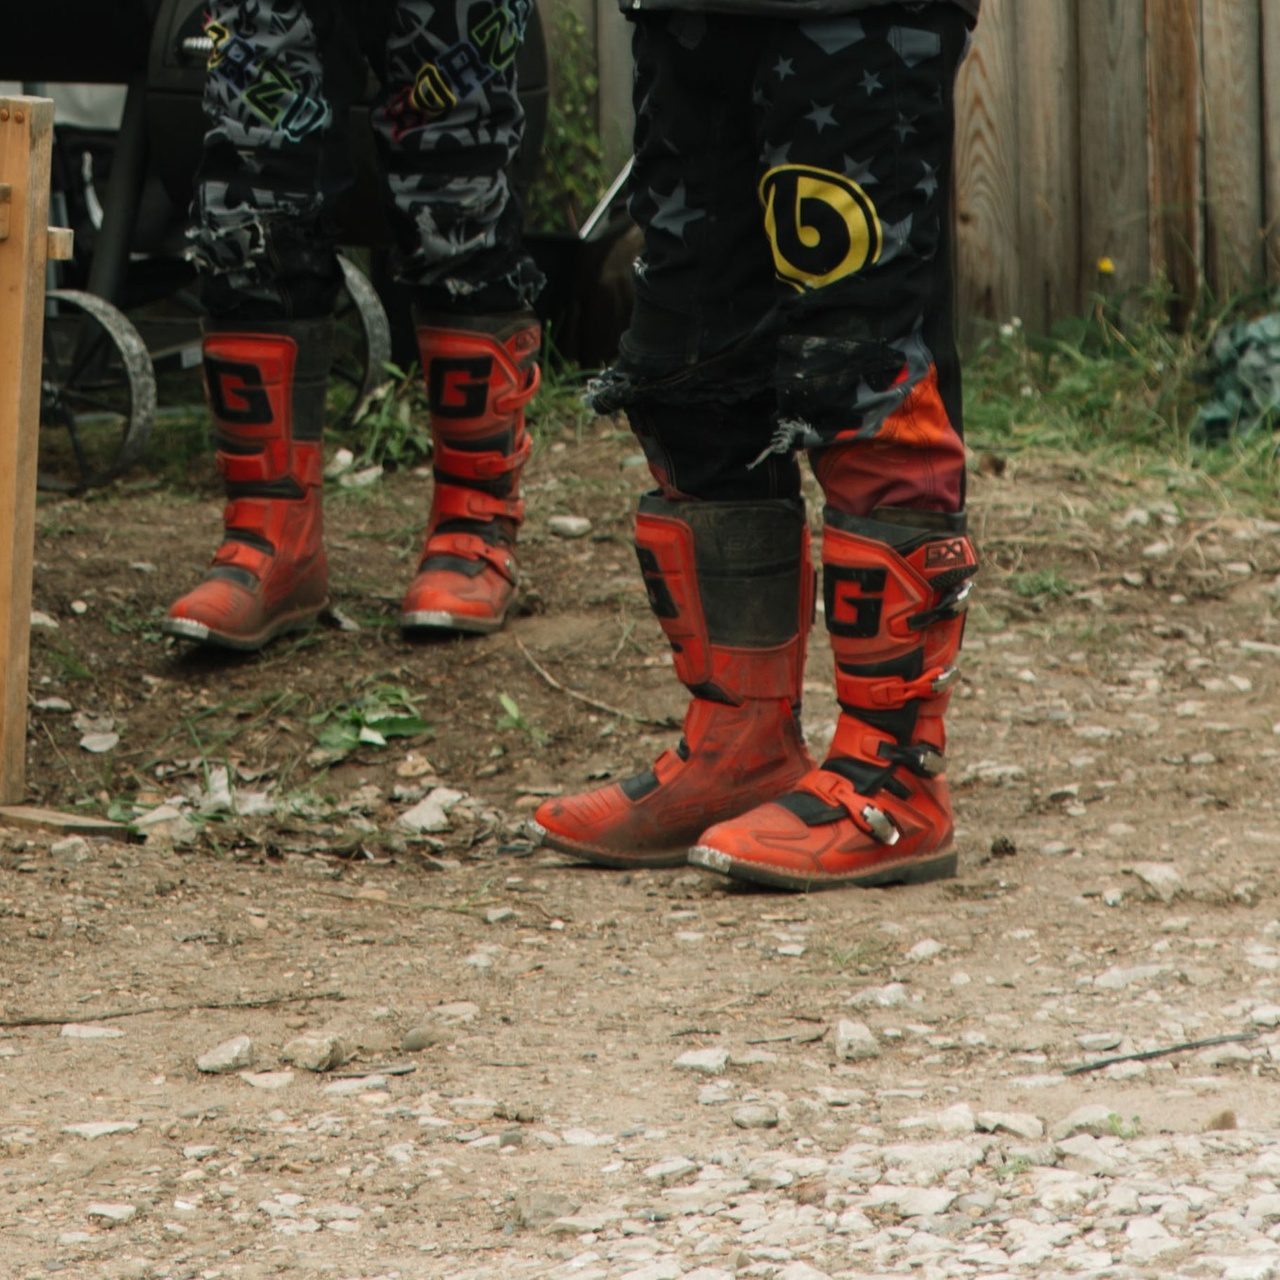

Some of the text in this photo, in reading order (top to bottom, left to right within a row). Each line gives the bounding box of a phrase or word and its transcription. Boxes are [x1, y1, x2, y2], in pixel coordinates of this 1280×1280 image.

[204, 11, 329, 142] ORZO
[428, 355, 494, 428] G
[822, 562, 888, 639] G
